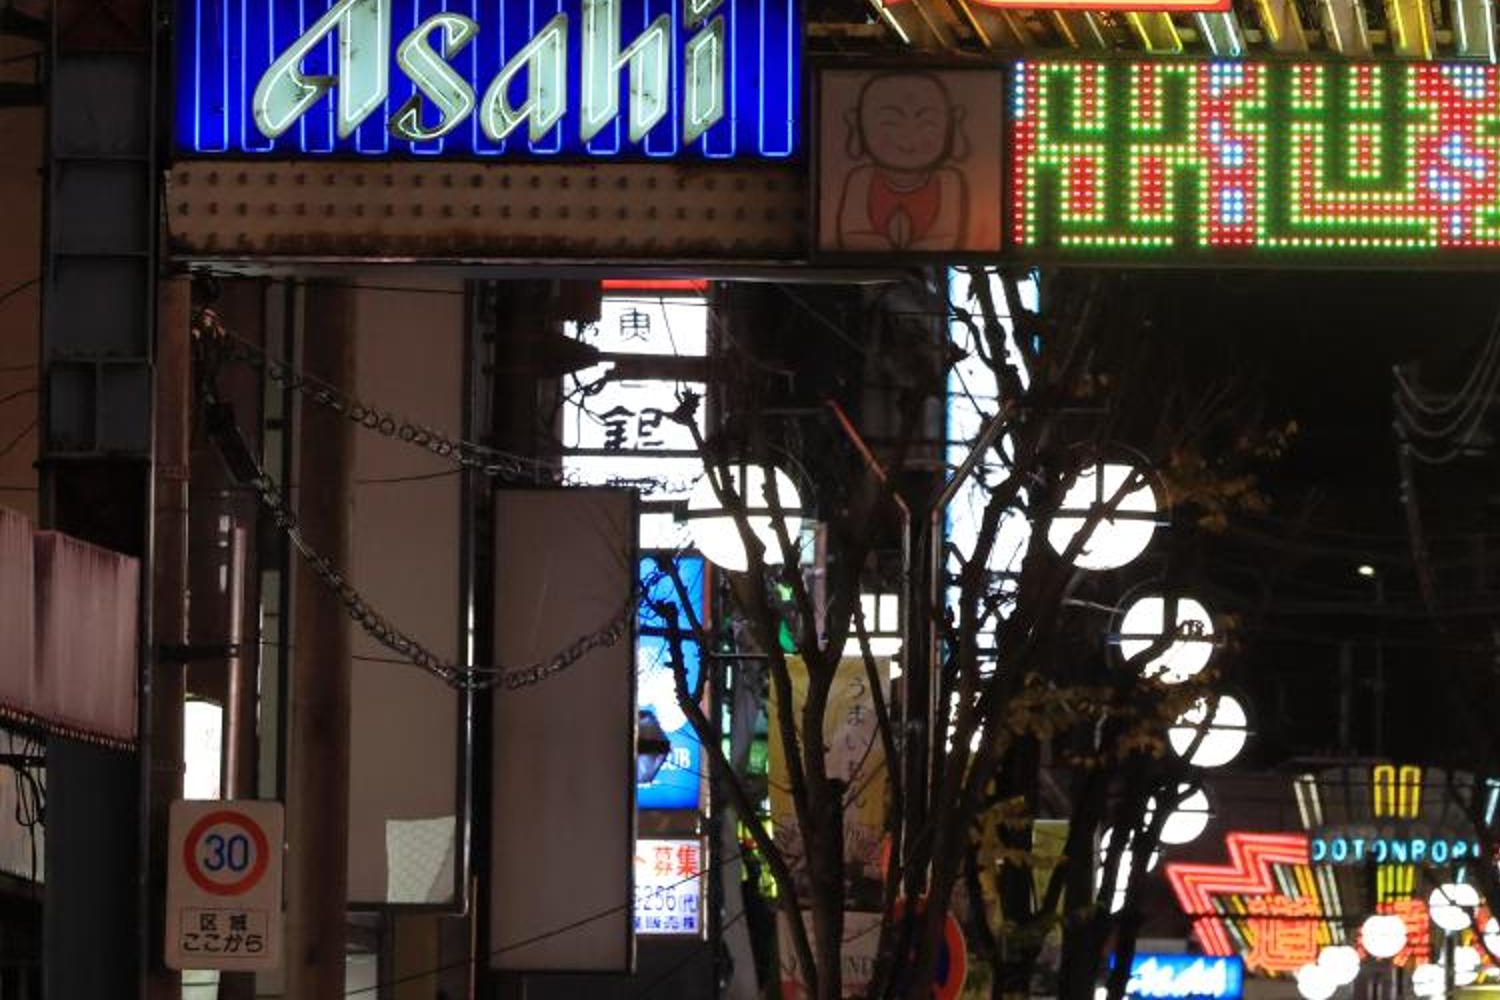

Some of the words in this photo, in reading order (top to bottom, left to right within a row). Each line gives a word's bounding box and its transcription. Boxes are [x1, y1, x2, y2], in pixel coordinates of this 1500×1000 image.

[203, 833, 249, 872] 30
[183, 933, 263, 953] ここから
